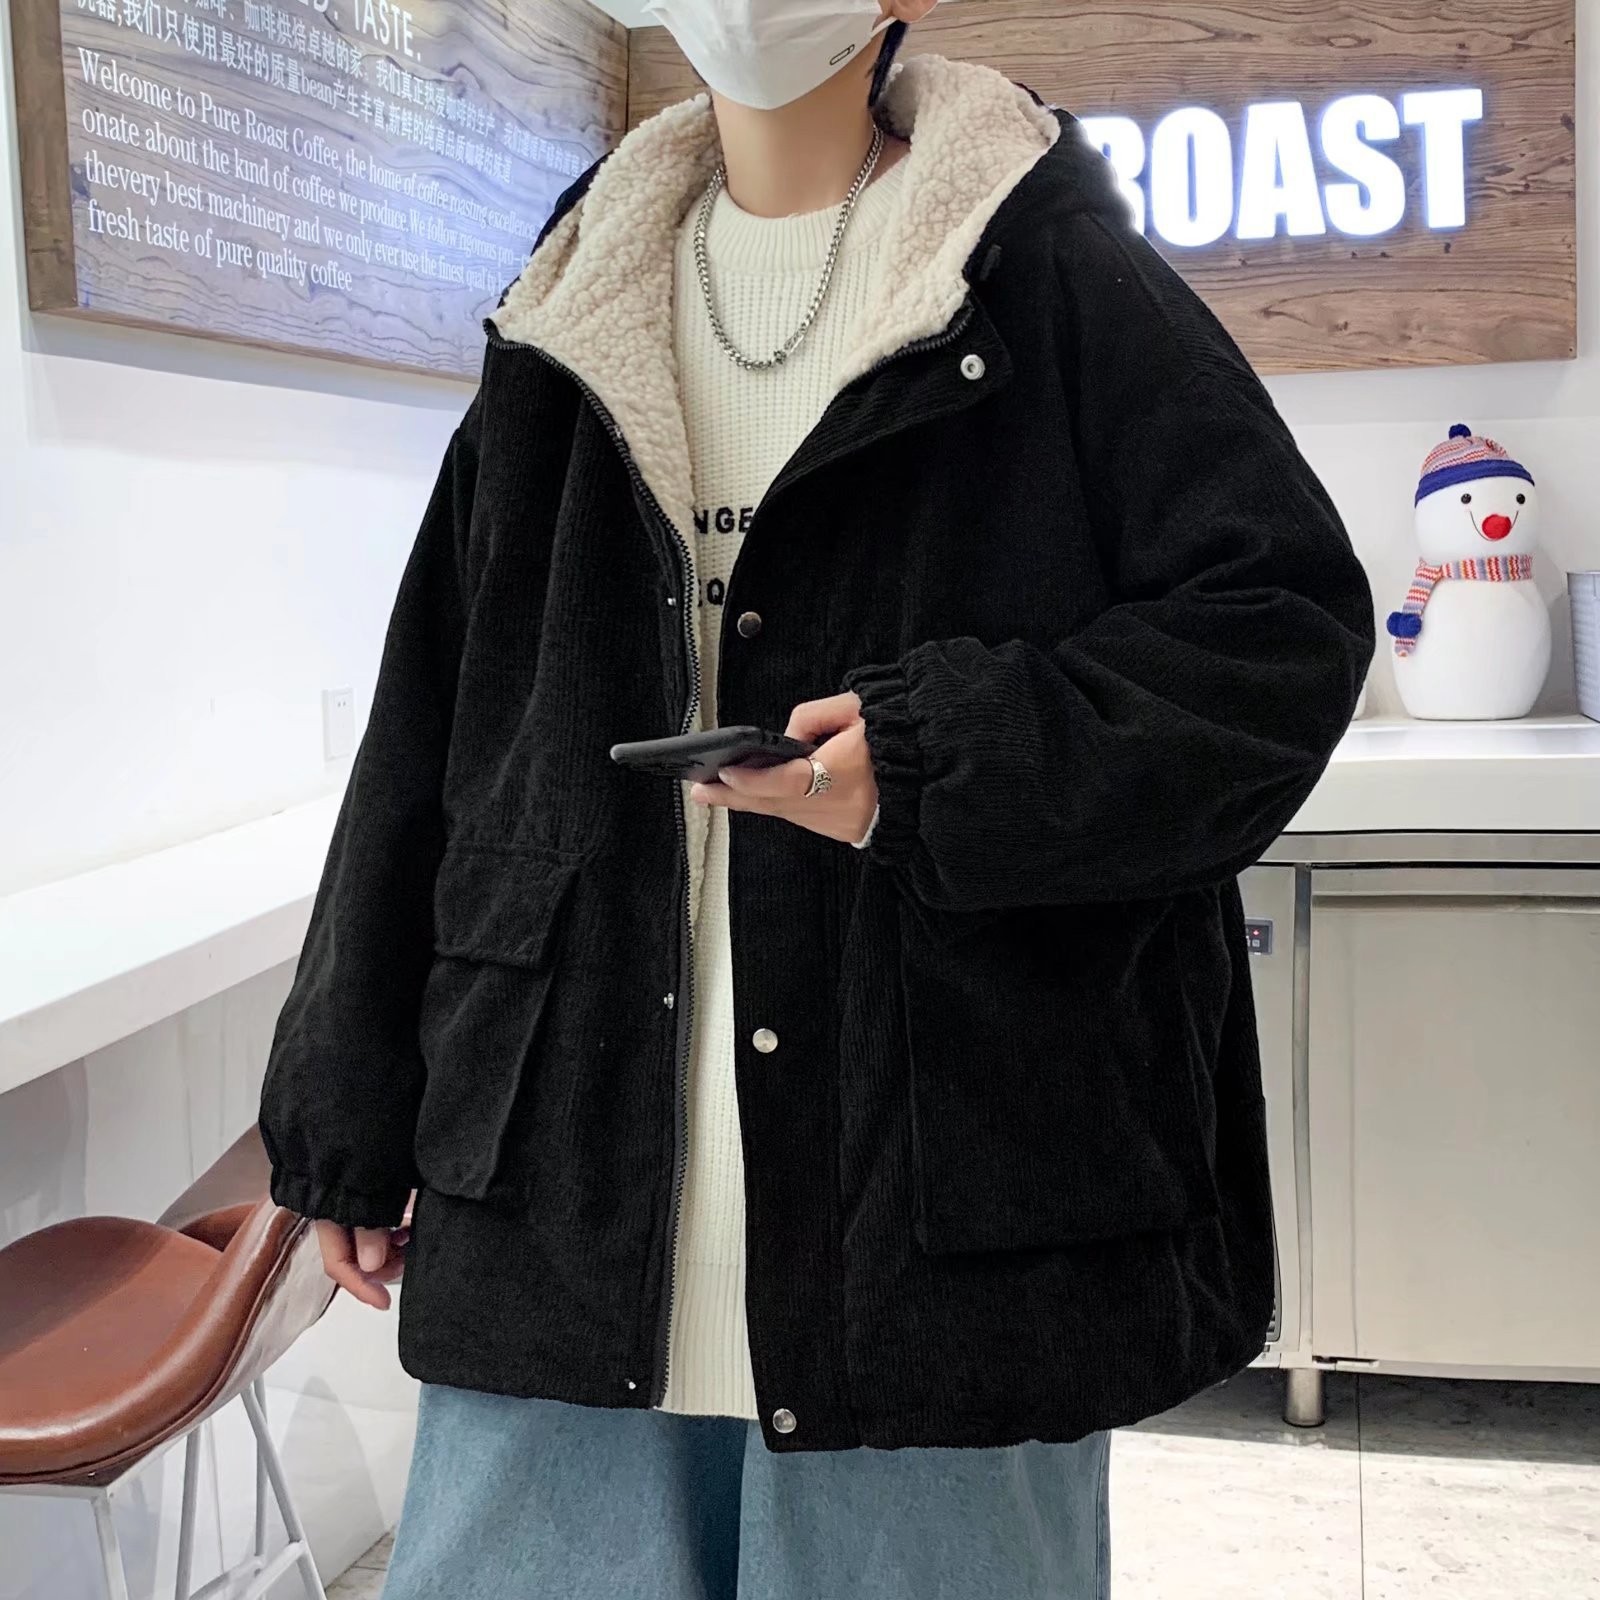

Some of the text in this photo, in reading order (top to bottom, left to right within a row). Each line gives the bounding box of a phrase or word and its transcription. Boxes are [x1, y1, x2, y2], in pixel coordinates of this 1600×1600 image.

[78, 47, 172, 111] Welcome
[176, 86, 196, 119] to
[200, 91, 241, 135] Pure
[244, 108, 289, 152] Roast
[293, 127, 342, 177] Coffee,
[345, 149, 366, 180] the
[369, 155, 402, 193] home
[404, 173, 417, 197] of
[418, 180, 449, 210] coffee
[450, 195, 488, 229] roasting
[82, 108, 140, 147] onate
[145, 122, 199, 166] about
[202, 139, 230, 175] the
[234, 148, 269, 187] kind
[273, 165, 290, 194] of
[292, 174, 336, 208] coffee
[338, 191, 357, 215] we
[360, 198, 409, 232] produce.
[410, 208, 426, 237] We
[427, 215, 459, 246] follow
[459, 233, 498, 259] rigorous
[84, 149, 161, 206] thevery
[165, 171, 204, 212] best
[207, 192, 290, 241] machinery
[294, 215, 320, 244] and
[323, 225, 343, 250] we
[346, 230, 373, 264] only
[374, 242, 398, 266] ever
[401, 249, 419, 272] use
[420, 249, 437, 276] the
[438, 254, 465, 284] finest
[88, 199, 353, 291] fresh taste of pure quality coffee
